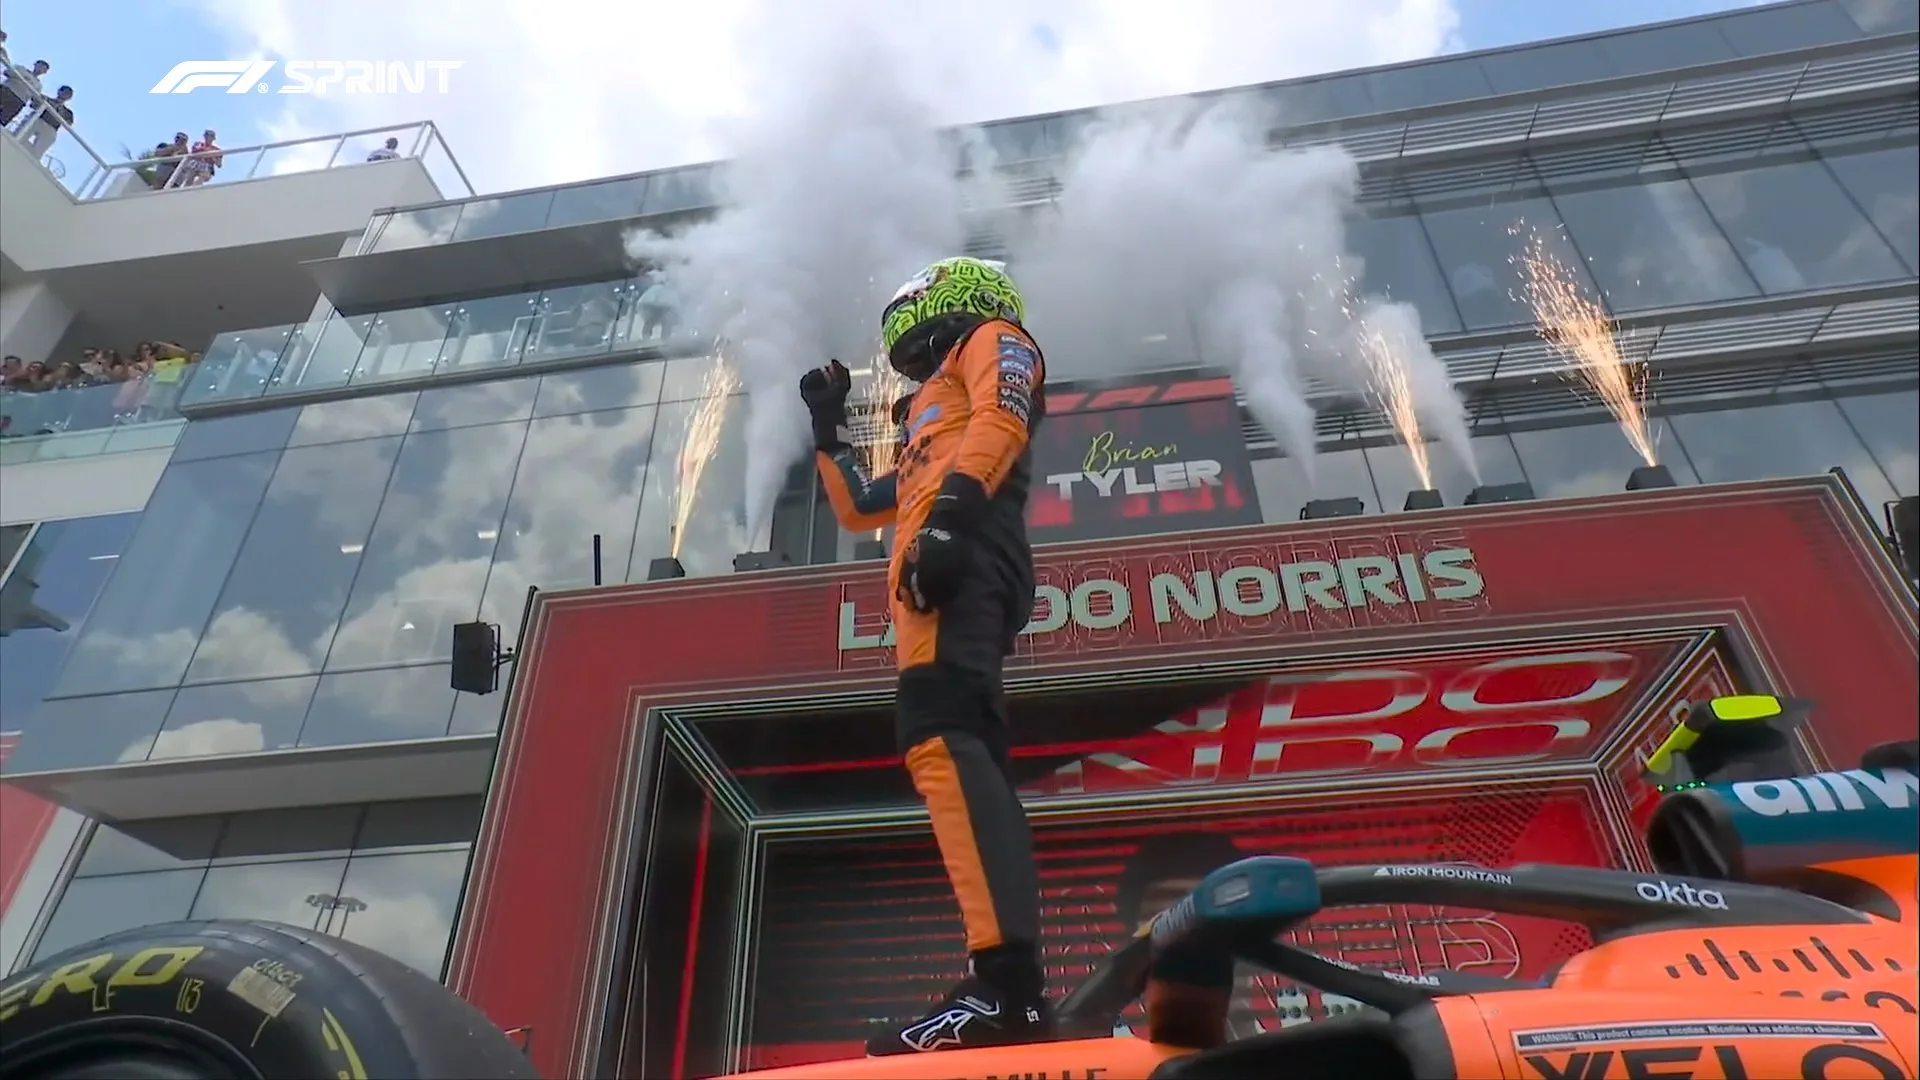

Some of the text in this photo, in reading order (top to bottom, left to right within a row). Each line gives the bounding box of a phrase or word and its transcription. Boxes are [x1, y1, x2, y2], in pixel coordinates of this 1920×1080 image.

[1082, 431, 1178, 474] Brian
[1046, 459, 1223, 499] TYLER
[838, 548, 1485, 650] LDO NORRIS
[1392, 867, 1512, 885] IRON MOUNTAIN
[1636, 880, 1729, 910] okta
[1598, 1030, 1630, 1041] product
